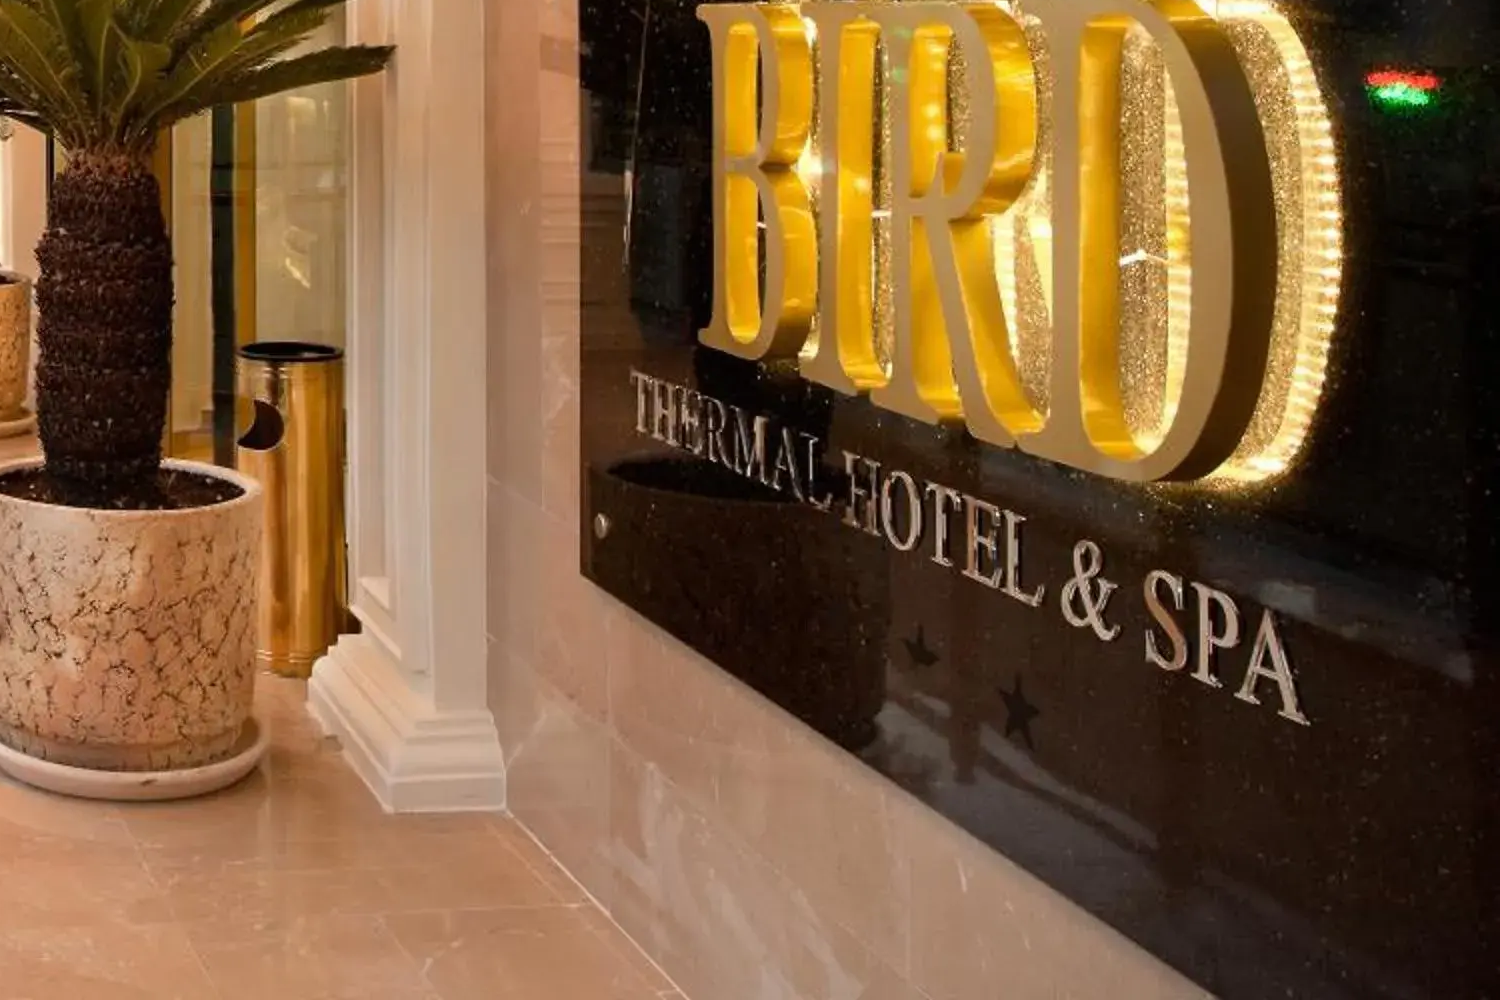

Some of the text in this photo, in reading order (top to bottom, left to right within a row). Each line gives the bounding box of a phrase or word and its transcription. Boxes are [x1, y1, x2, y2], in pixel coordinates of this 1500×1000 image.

[630, 366, 1312, 726] THERMAL HOTEL & SPA
